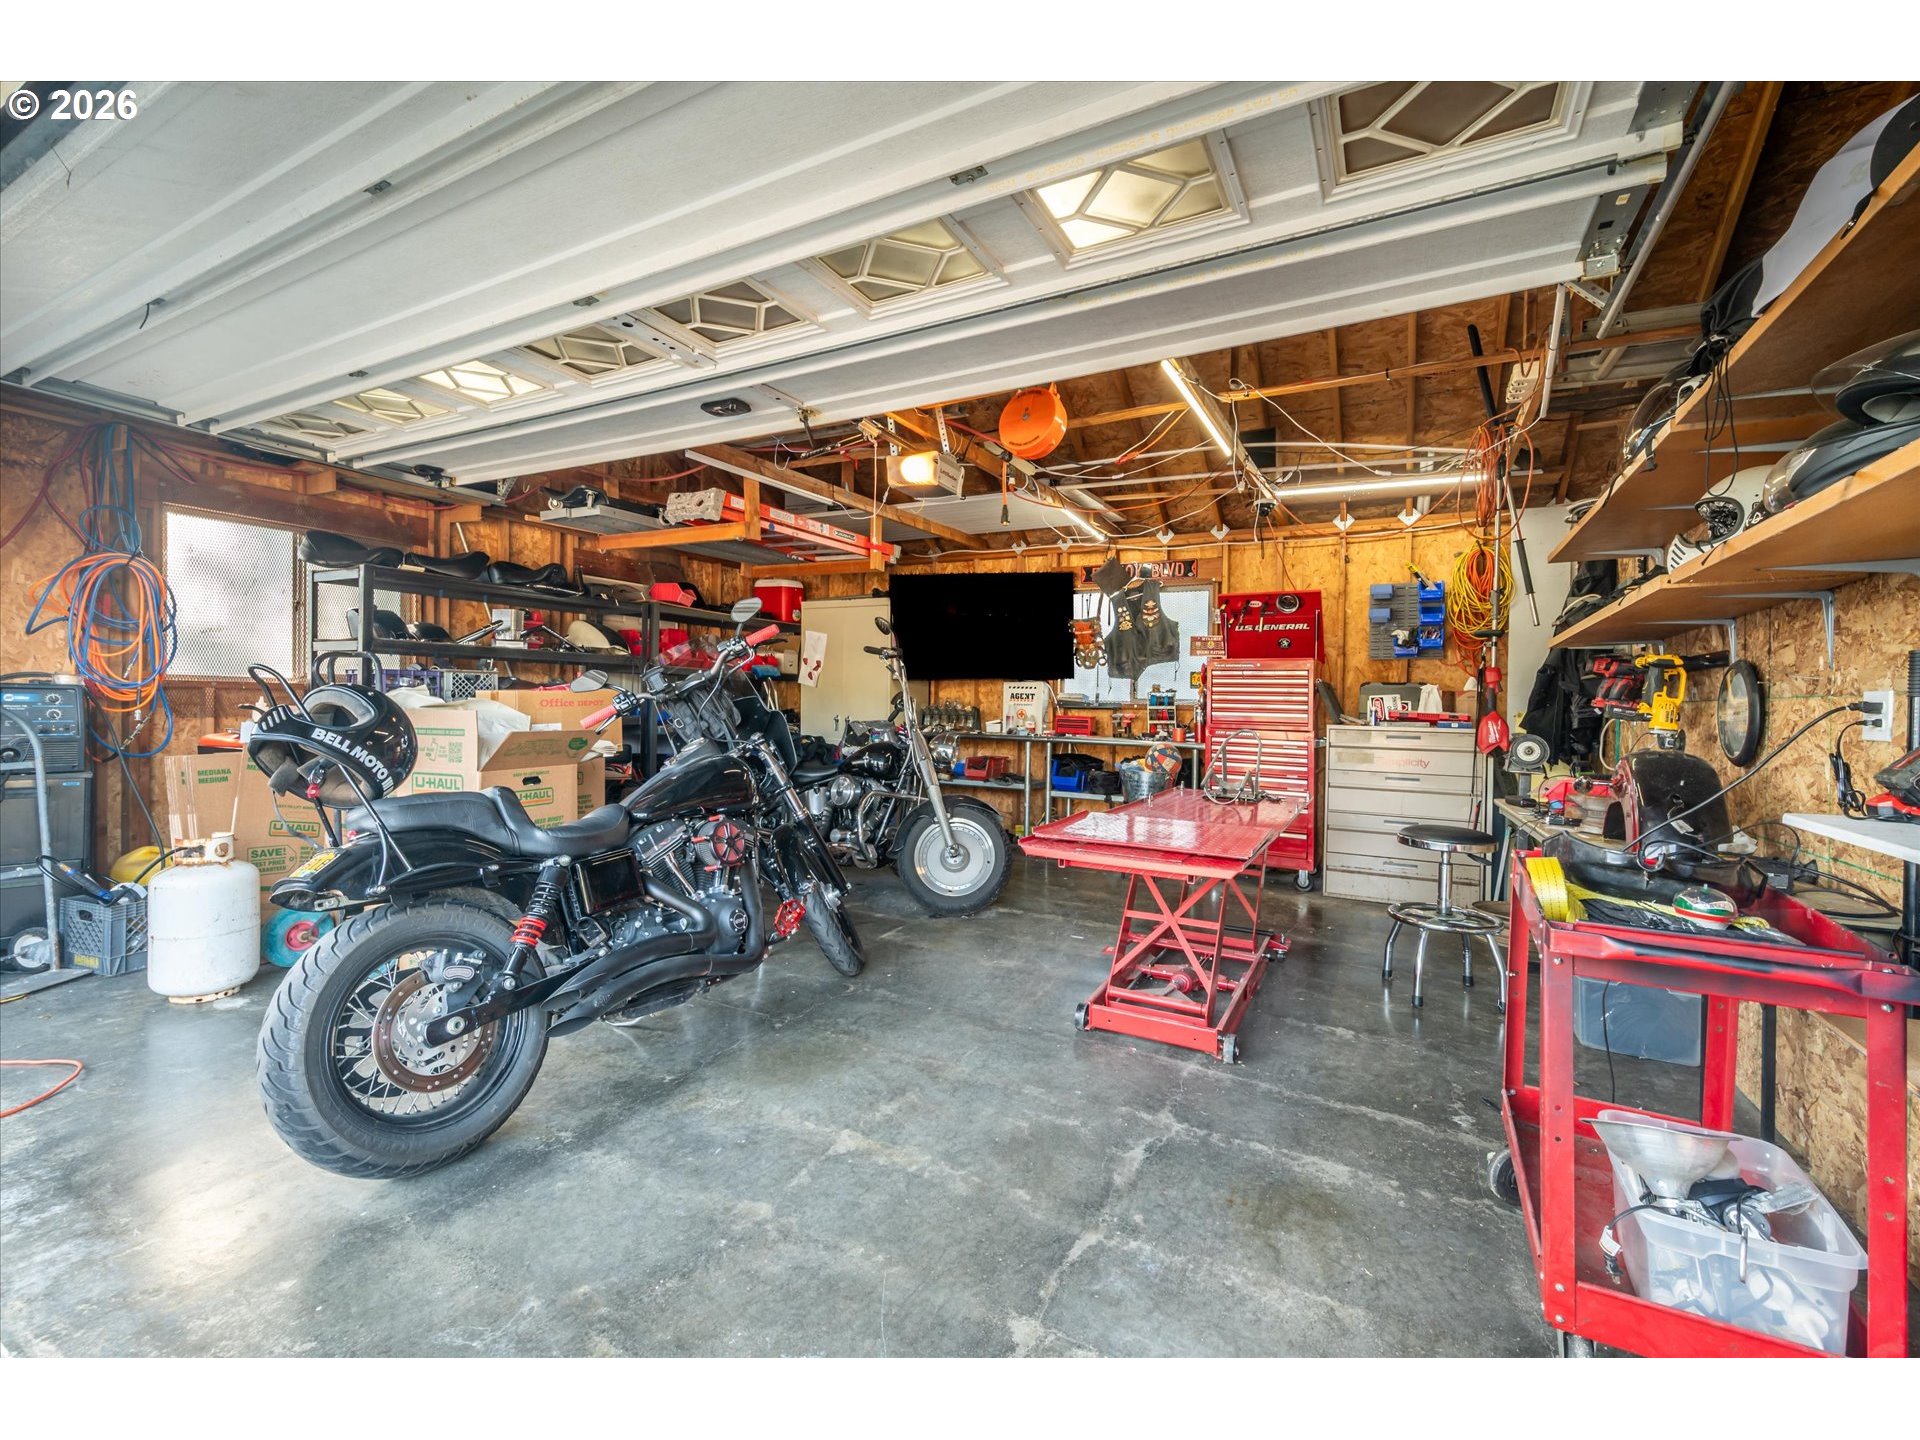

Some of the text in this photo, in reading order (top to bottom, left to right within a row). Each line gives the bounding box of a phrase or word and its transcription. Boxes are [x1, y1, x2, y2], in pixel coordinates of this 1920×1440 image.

[1151, 561, 1185, 578] BLVD
[1010, 692, 1036, 700] AGENT
[540, 698, 604, 708] Office DEPOT
[311, 727, 351, 754] BELL
[349, 745, 390, 780] MOTO
[1381, 754, 1431, 769] mplicity
[197, 768, 233, 776] MEDIANA
[198, 776, 229, 785] MEDIUM
[415, 776, 461, 791] U-HAUL
[272, 822, 318, 833] UHAUL
[251, 847, 287, 859] SAVE!
